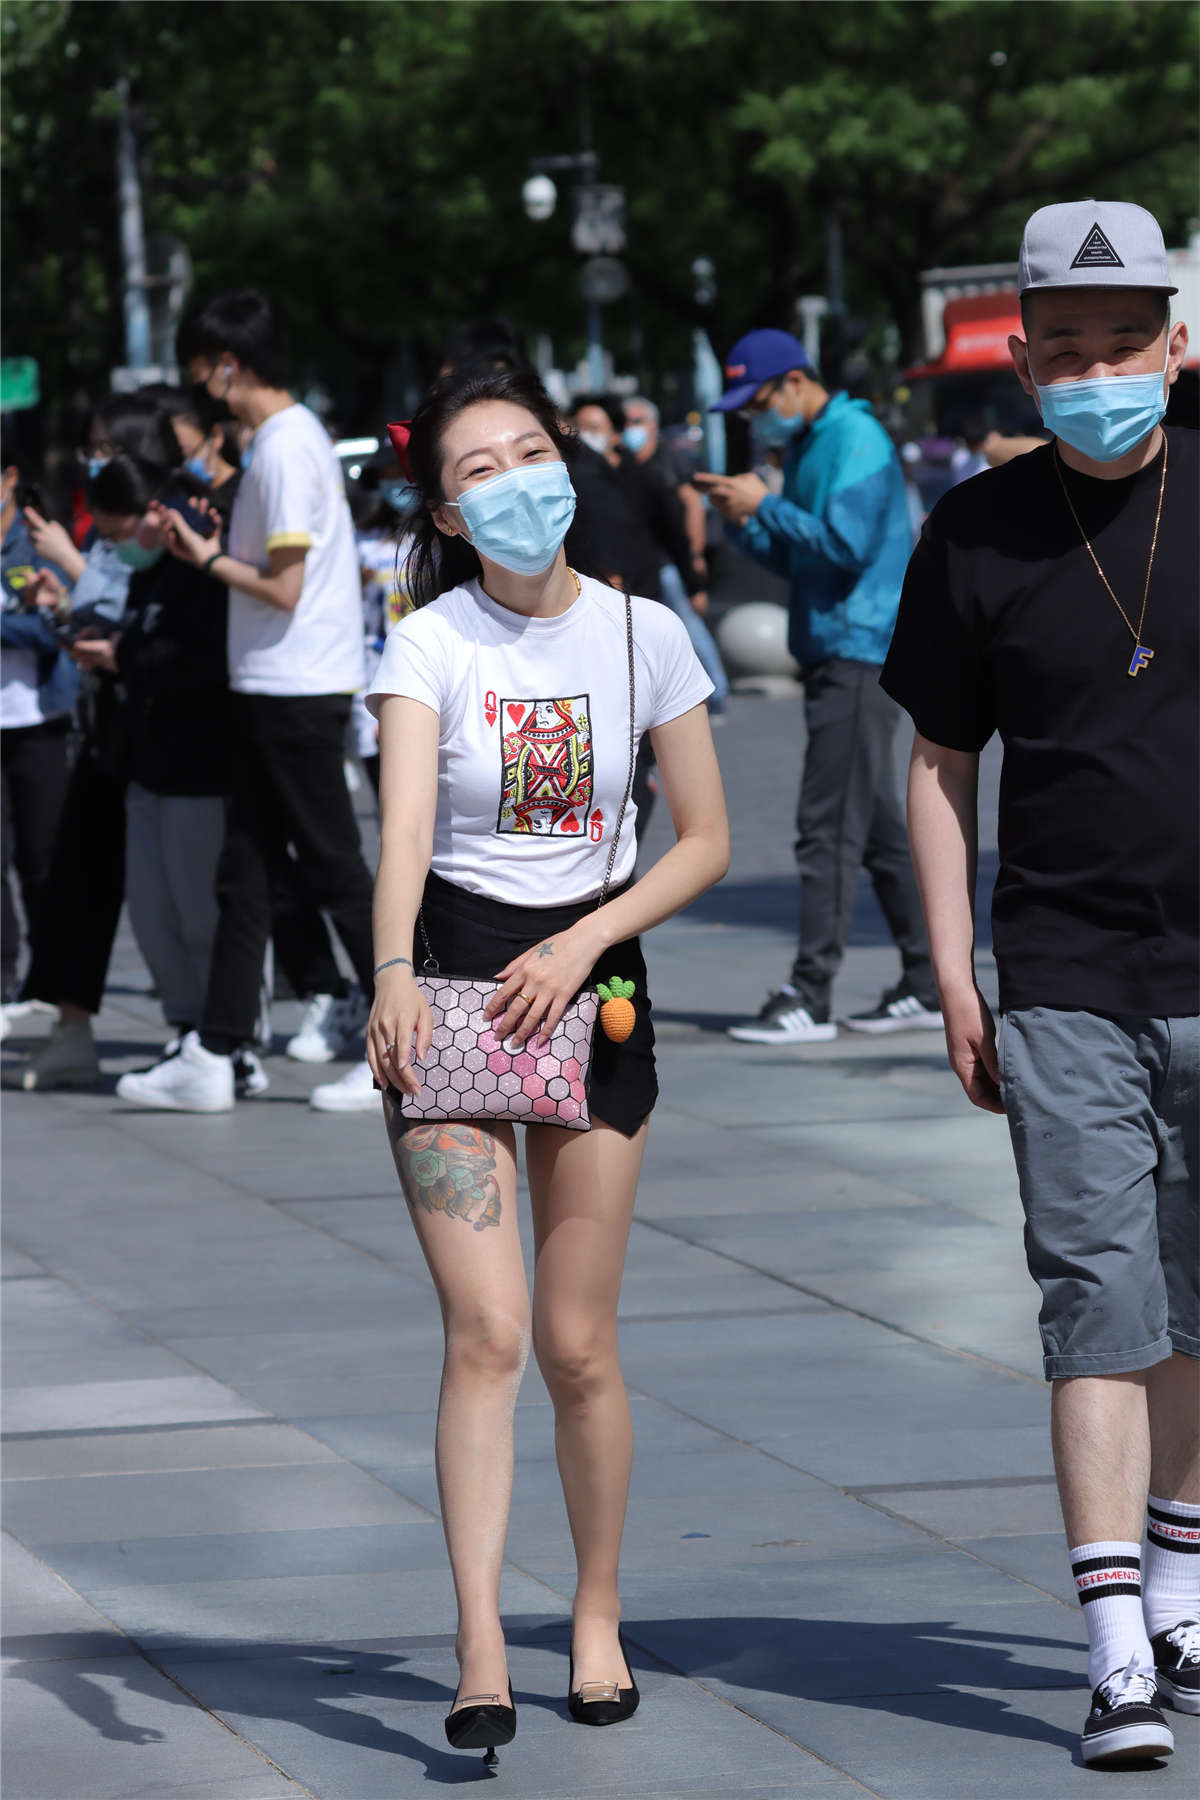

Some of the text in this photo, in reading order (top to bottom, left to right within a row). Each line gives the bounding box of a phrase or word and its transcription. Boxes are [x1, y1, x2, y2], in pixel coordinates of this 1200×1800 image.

[1128, 645, 1154, 677] F
[484, 691, 498, 712] Q
[590, 820, 604, 842] Q
[1150, 1521, 1200, 1540] VETEME
[1077, 1570, 1140, 1588] VETEMENTS
